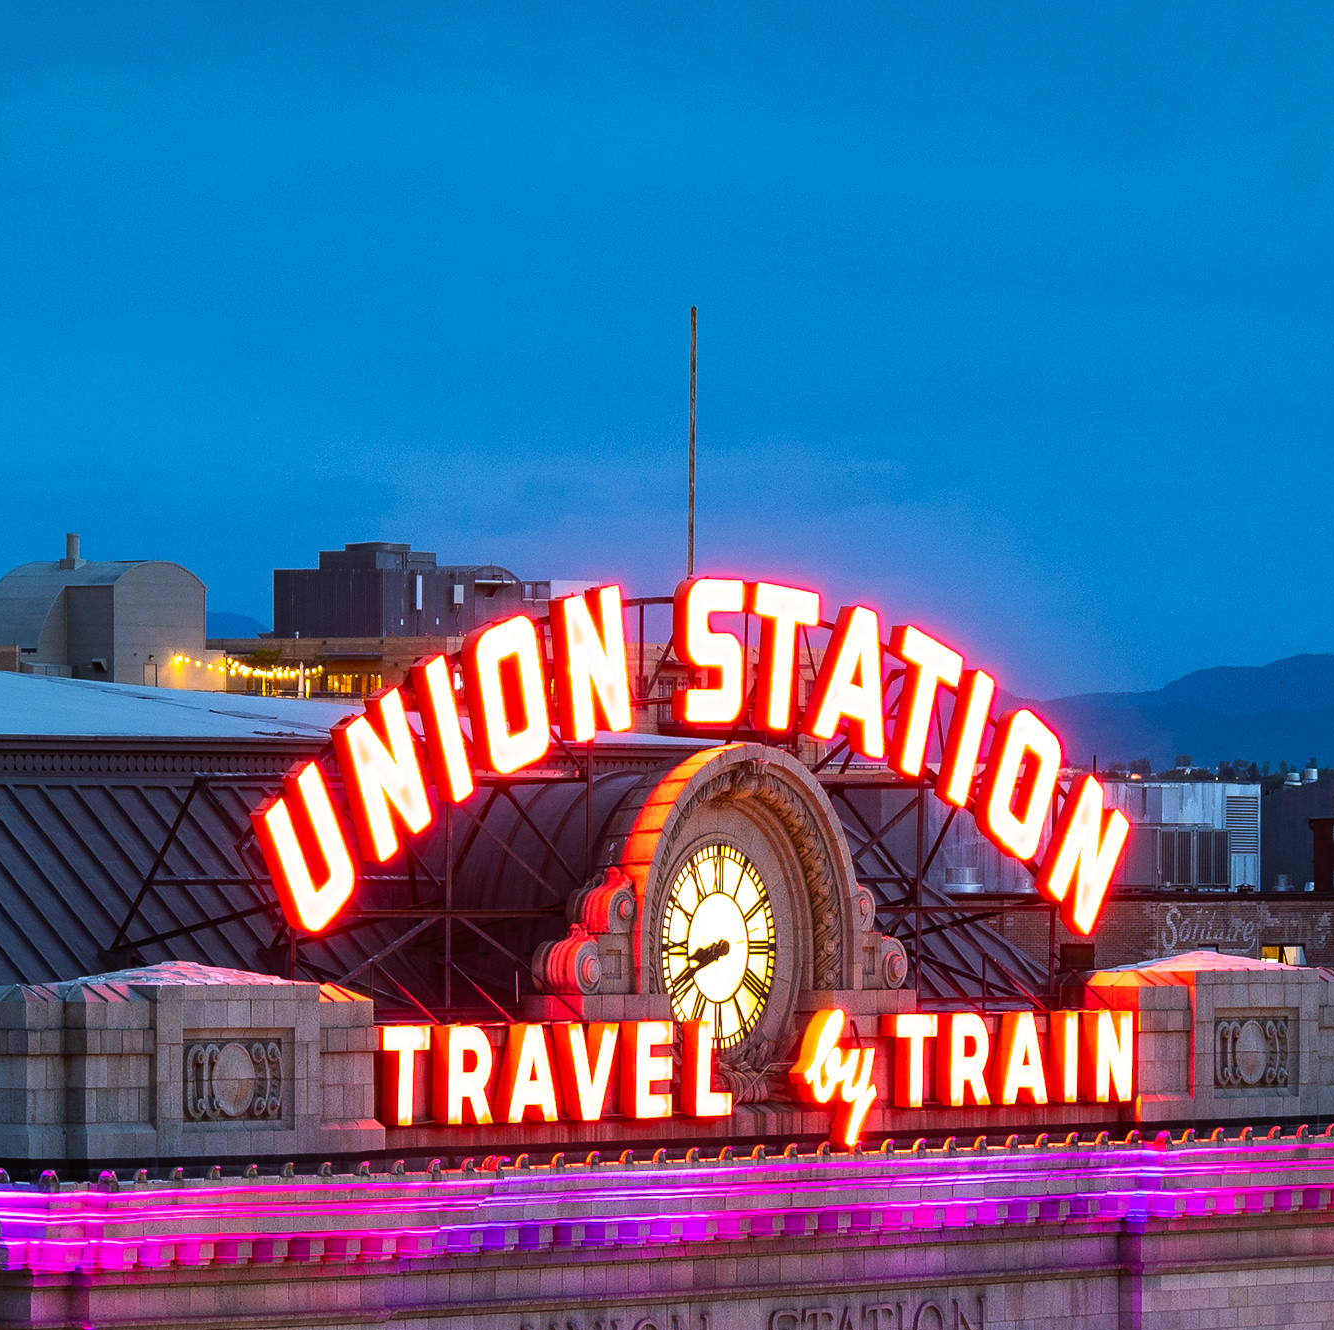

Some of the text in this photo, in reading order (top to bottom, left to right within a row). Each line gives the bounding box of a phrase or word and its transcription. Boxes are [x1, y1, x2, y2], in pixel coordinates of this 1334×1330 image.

[255, 577, 1131, 936] UNION STATION
[381, 1008, 1133, 1146] TRAVEL by TRAIN
